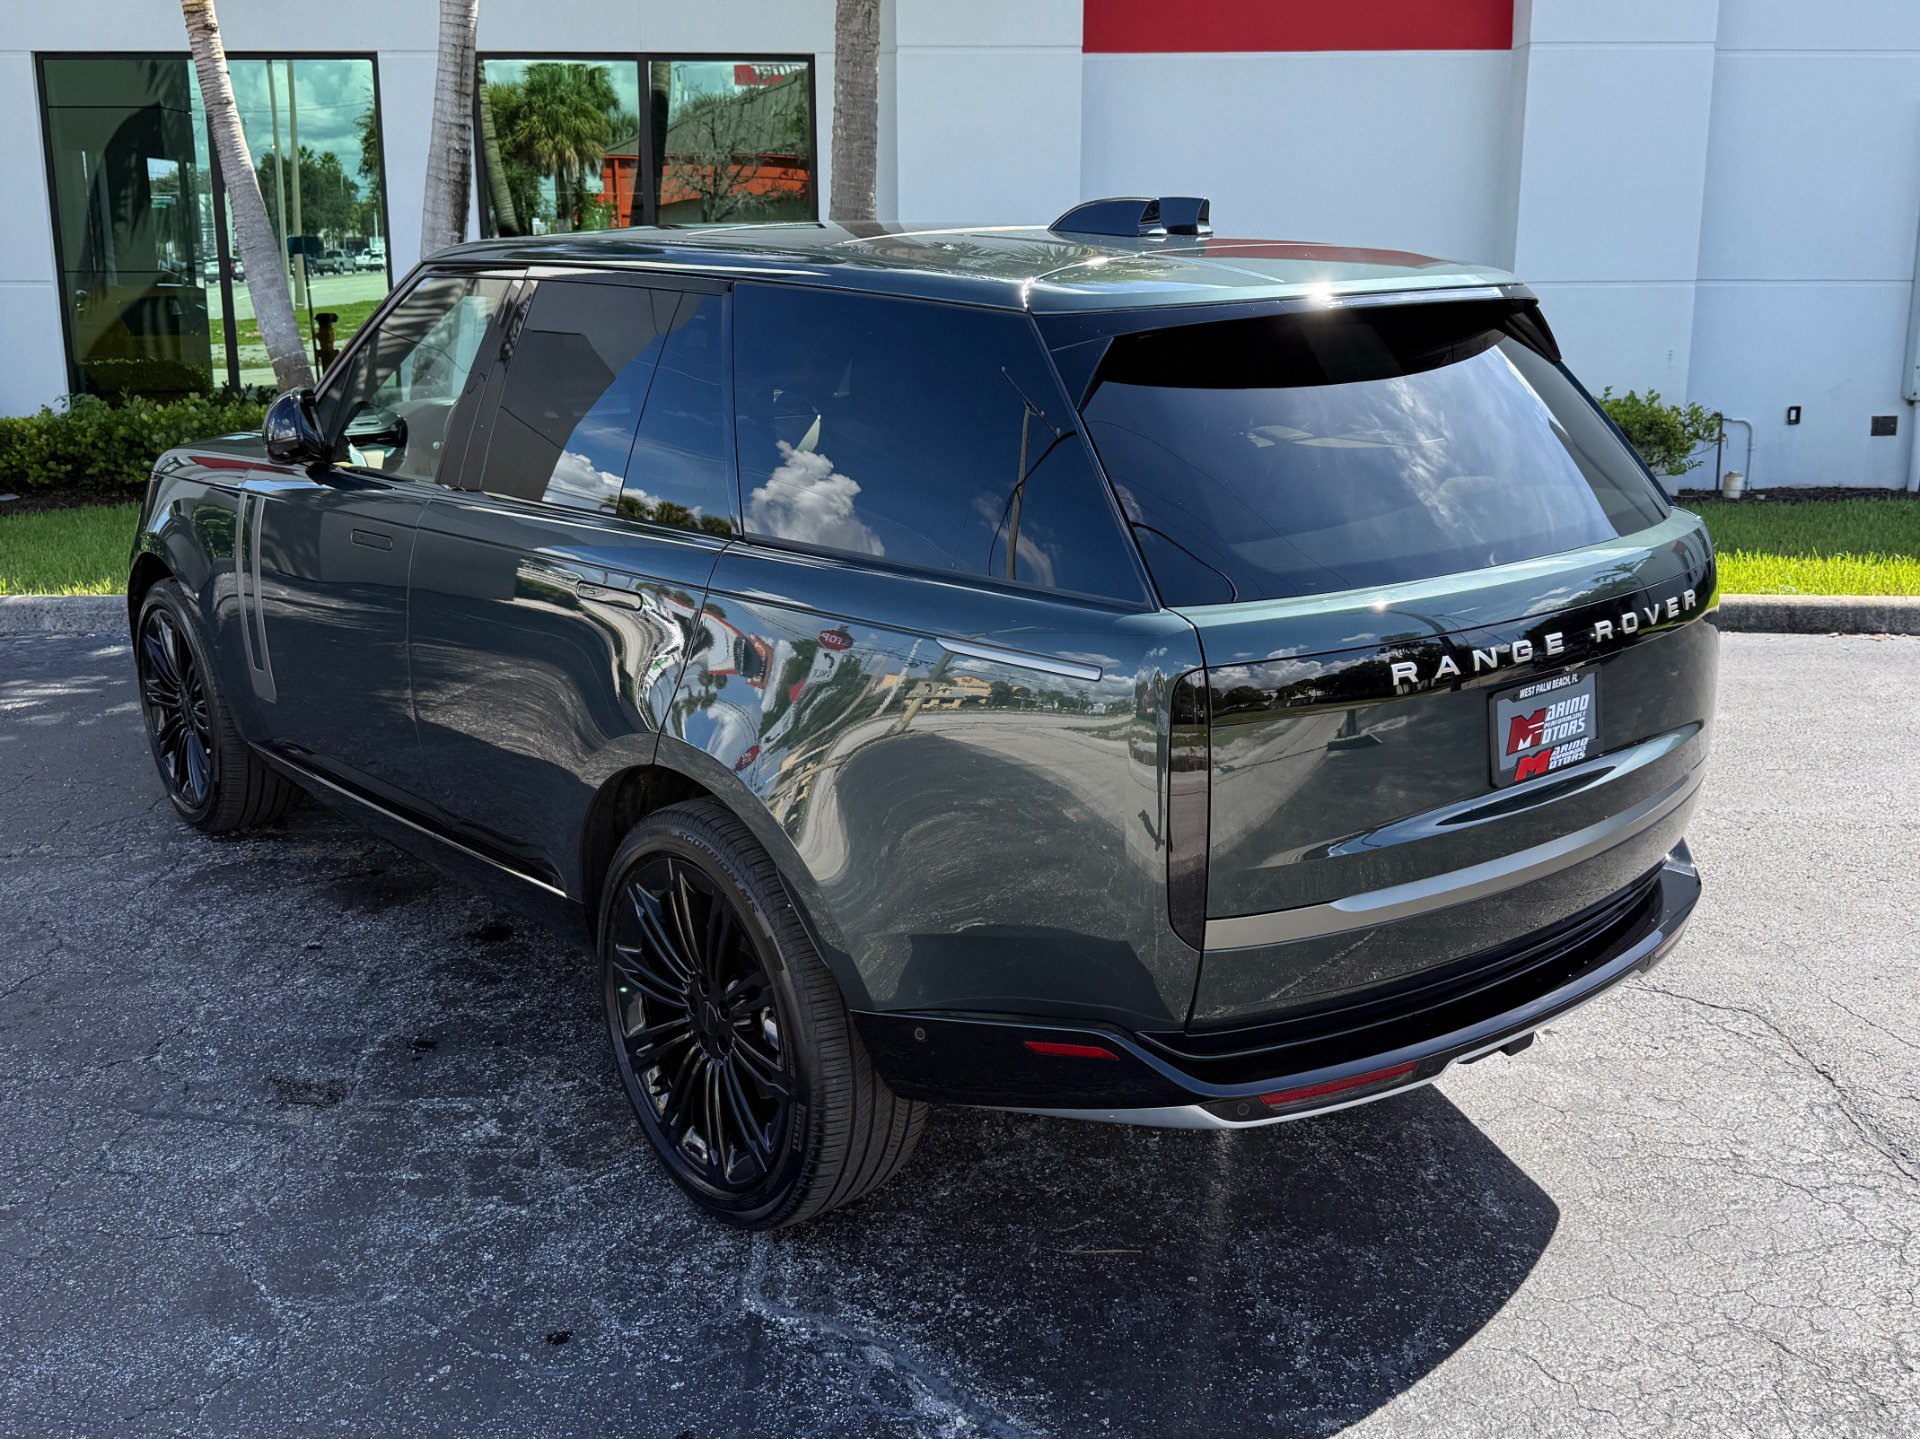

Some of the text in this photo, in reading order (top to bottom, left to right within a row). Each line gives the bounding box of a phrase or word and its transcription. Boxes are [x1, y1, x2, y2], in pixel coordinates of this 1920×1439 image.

[1391, 589, 1697, 686] RANGE ROVER
[1519, 673, 1578, 699] WEST PALM BEACH, FL
